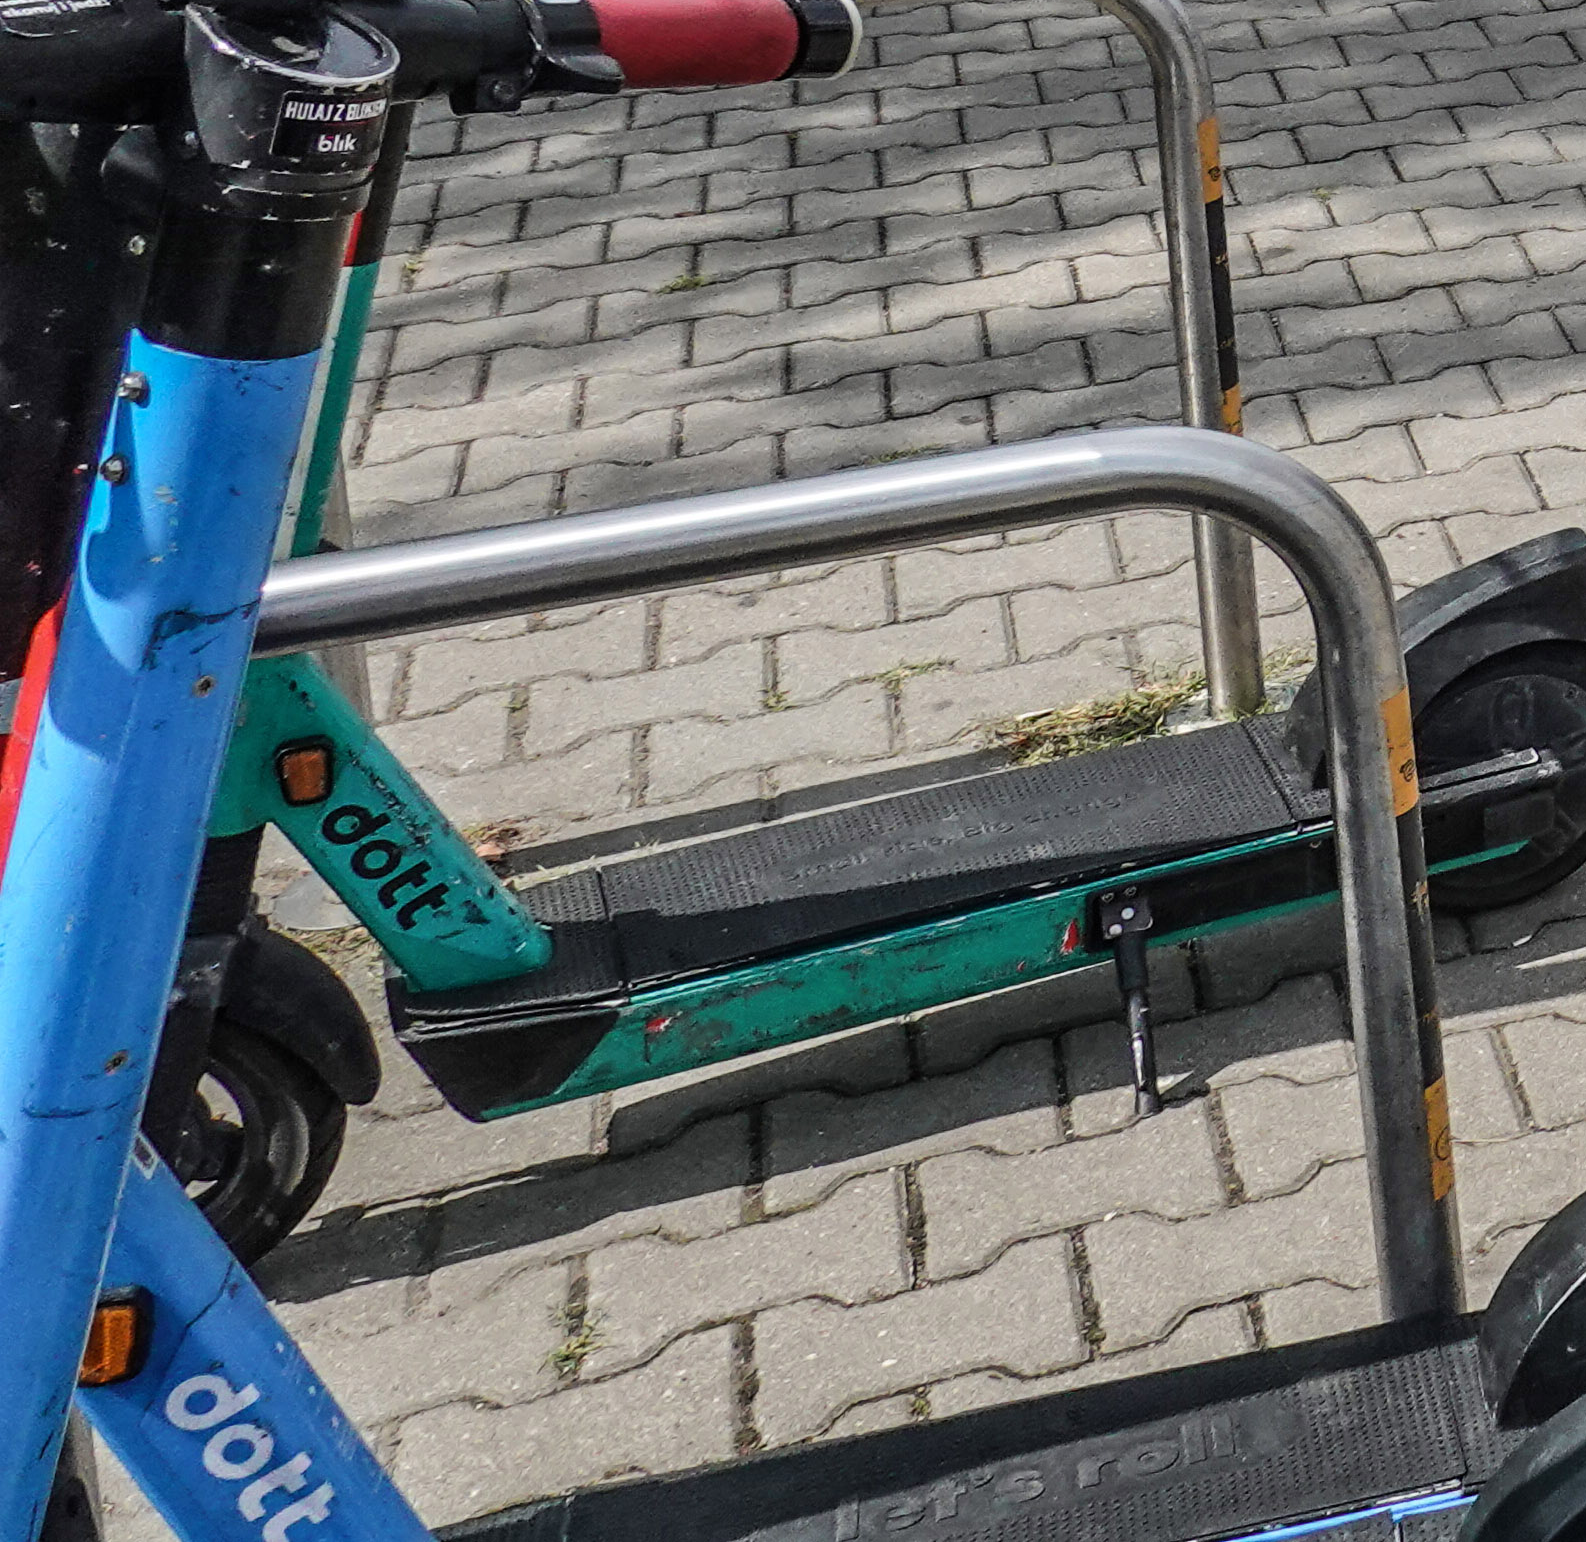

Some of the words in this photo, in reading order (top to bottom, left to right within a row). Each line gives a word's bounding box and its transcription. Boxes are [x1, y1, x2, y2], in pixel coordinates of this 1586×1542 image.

[284, 100, 334, 121] HULAJ
[332, 104, 346, 122] Z
[317, 132, 358, 153] blik
[321, 804, 450, 931] dott
[165, 1374, 336, 1542] dott
[1076, 1410, 1238, 1490] roll
